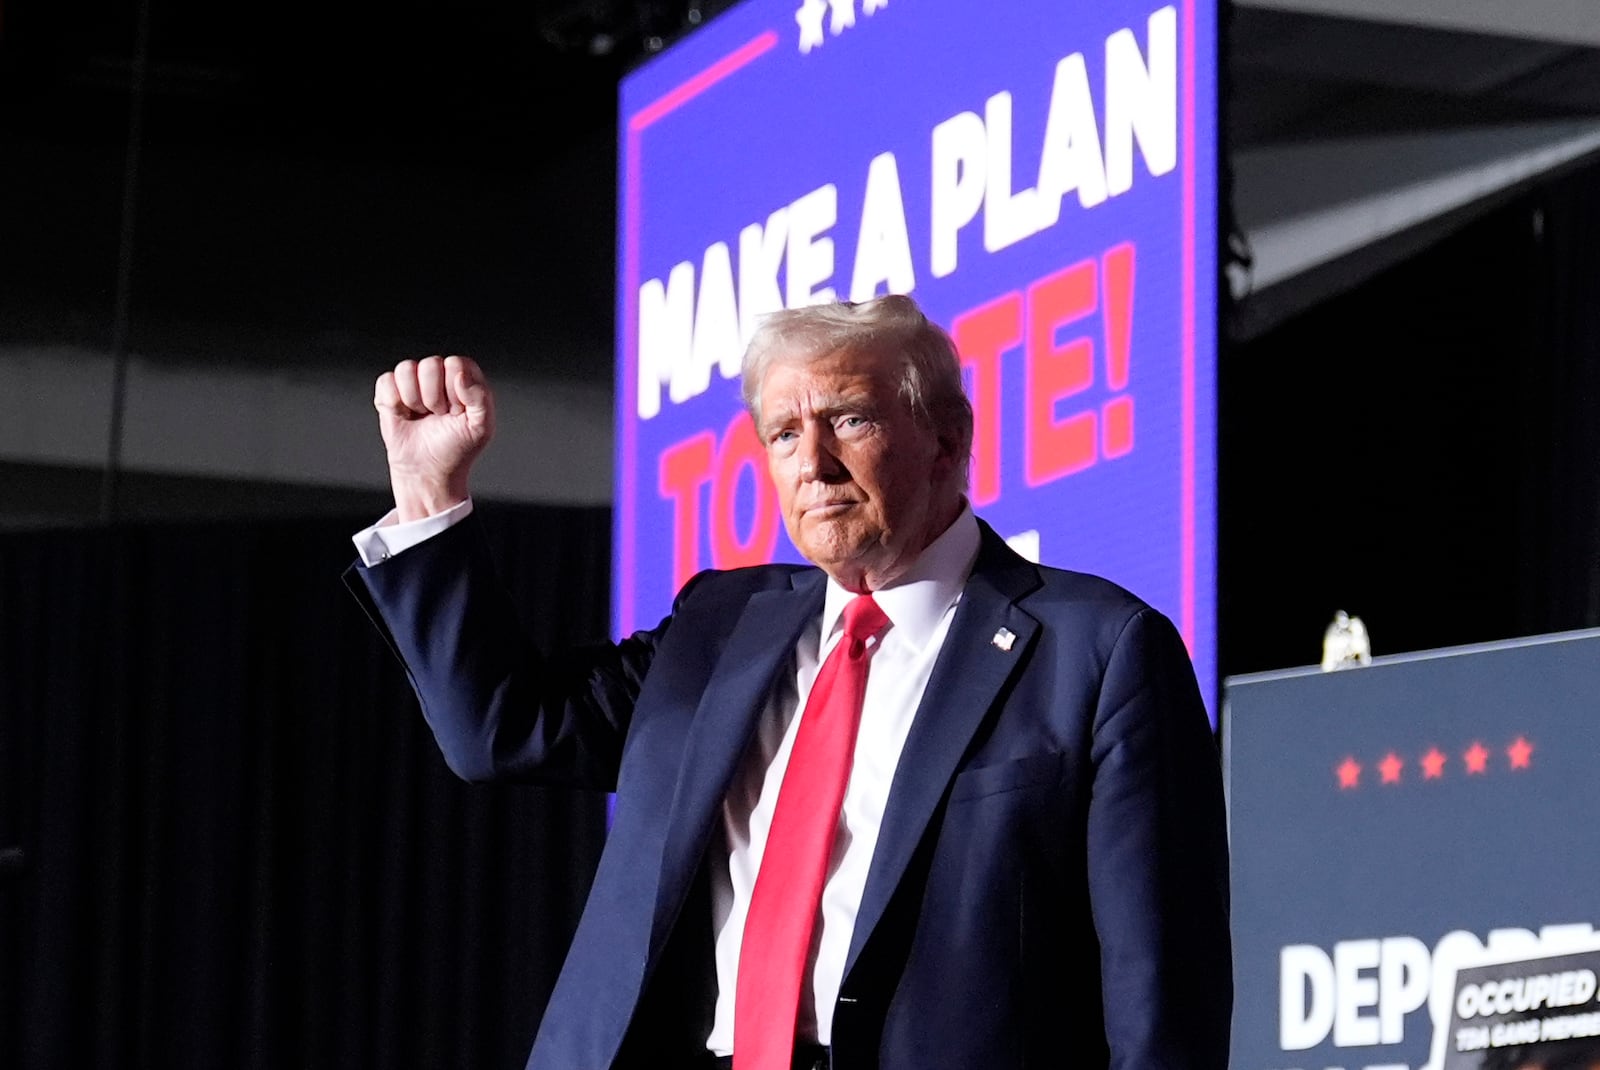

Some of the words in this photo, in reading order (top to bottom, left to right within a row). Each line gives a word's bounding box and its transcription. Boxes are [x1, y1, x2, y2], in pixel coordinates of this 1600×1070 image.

[638, 183, 838, 420] MAKE
[850, 151, 916, 305] A
[931, 5, 1178, 279] PLAN
[659, 408, 781, 600] TO
[952, 240, 1136, 507] TE!
[1456, 968, 1597, 1020] OCCUPIED
